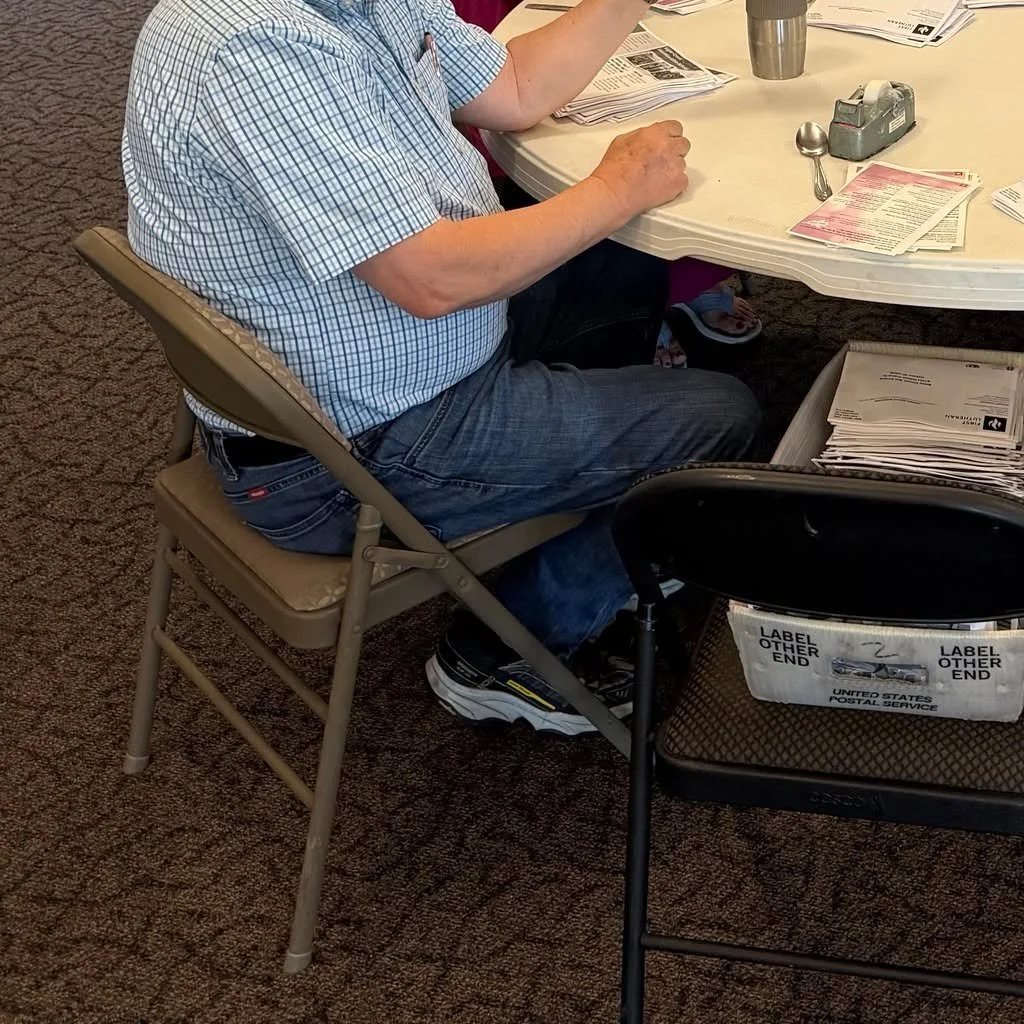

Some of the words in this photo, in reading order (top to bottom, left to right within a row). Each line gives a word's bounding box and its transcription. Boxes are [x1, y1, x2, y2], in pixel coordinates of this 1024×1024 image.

[760, 626, 817, 647] LABEL
[759, 638, 820, 659] OTHER
[940, 645, 1000, 658] LABEL
[772, 652, 810, 667] END
[938, 657, 1002, 669] OTHER
[951, 669, 991, 681] END
[832, 688, 880, 699] UNITED
[881, 692, 933, 703] STATES
[829, 696, 881, 707] POSTAL
[882, 699, 939, 712] SERVICE
